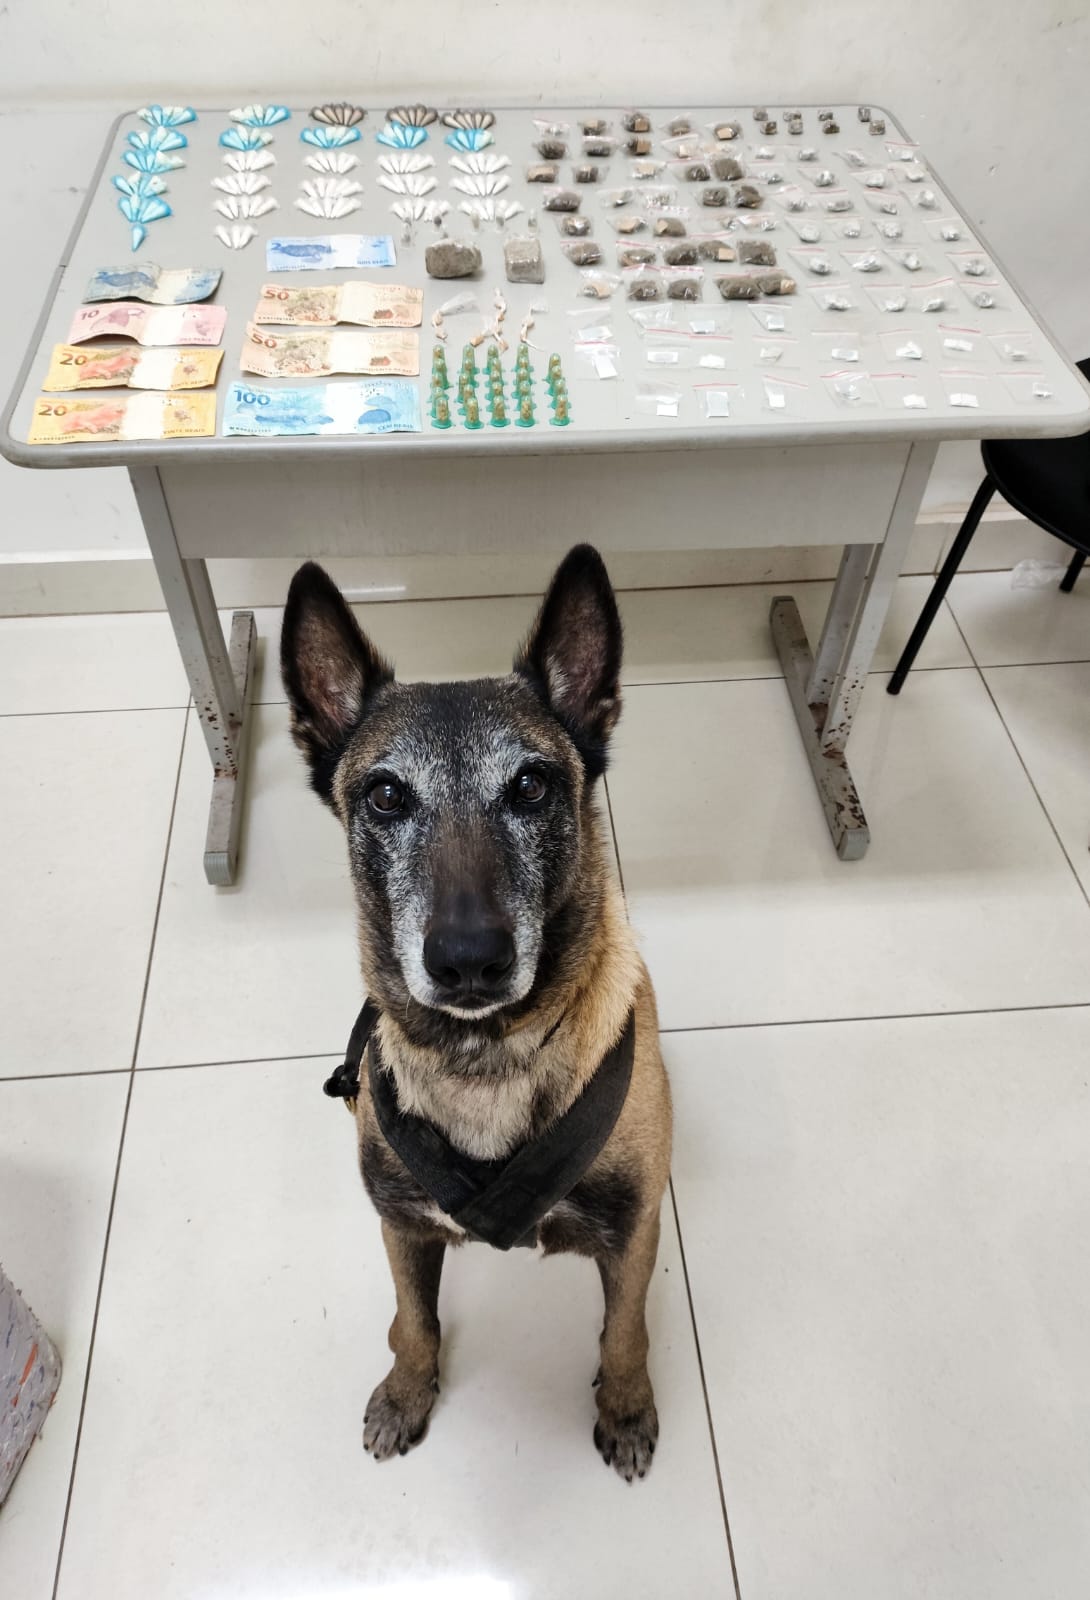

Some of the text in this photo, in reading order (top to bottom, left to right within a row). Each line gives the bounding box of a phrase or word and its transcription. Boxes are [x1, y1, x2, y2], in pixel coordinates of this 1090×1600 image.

[271, 242, 282, 251] 2
[263, 289, 290, 301] 50
[81, 310, 99, 320] 10
[251, 333, 277, 349] 50
[59, 353, 88, 366] 20
[233, 389, 272, 406] 100
[38, 404, 68, 417] 20
